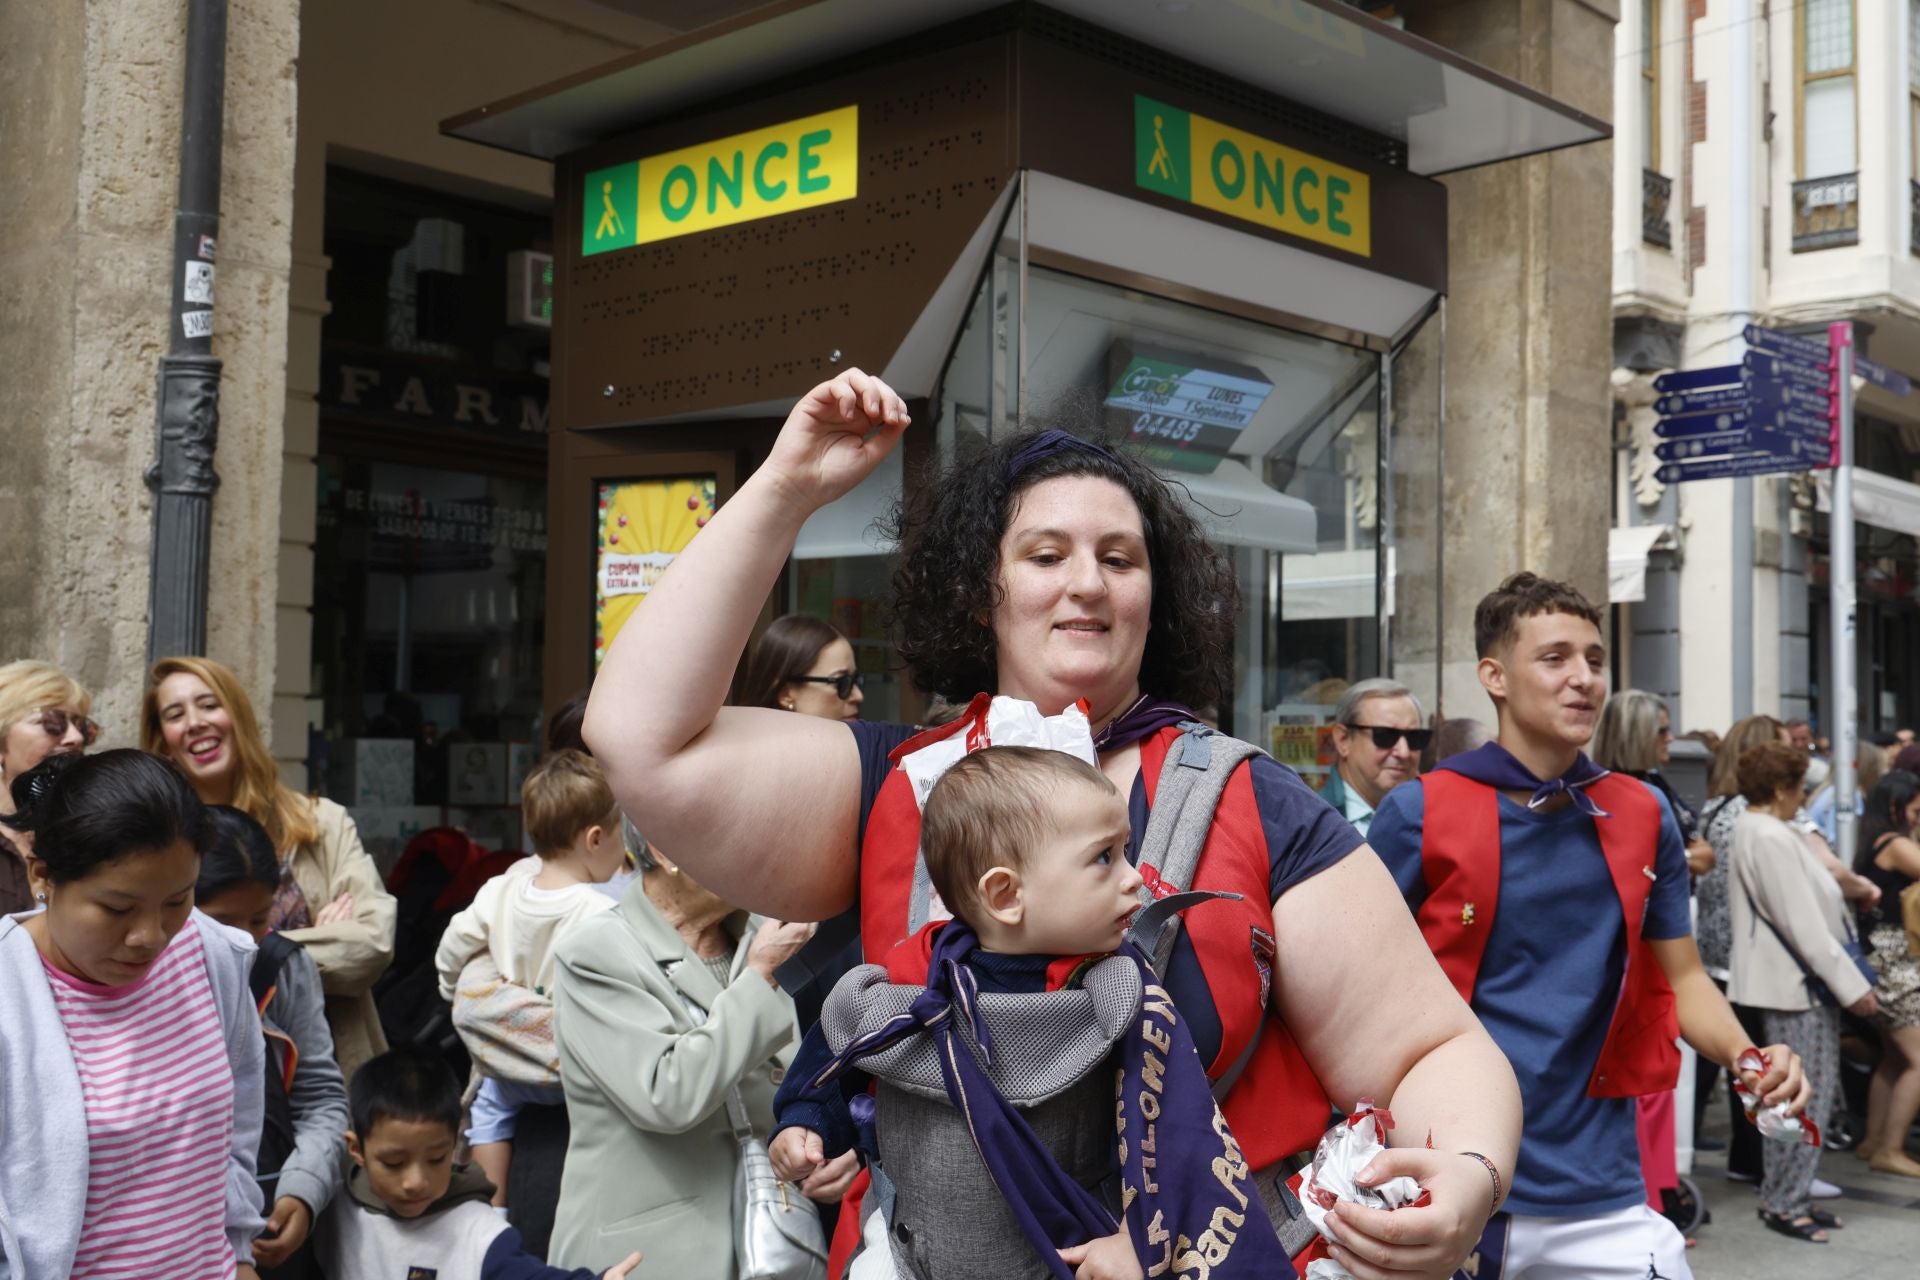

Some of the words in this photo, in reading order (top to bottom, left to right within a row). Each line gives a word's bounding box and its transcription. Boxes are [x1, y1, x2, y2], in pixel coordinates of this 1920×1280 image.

[660, 129, 832, 222] ONCE
[1211, 139, 1352, 237] ONCE
[1191, 401, 1246, 424] Septiembre
[1207, 387, 1246, 405] LUNES
[1133, 413, 1204, 443] 04485
[606, 578, 629, 589] EXTRA
[1148, 1209, 1171, 1277] LA
[1171, 1205, 1247, 1280] San
